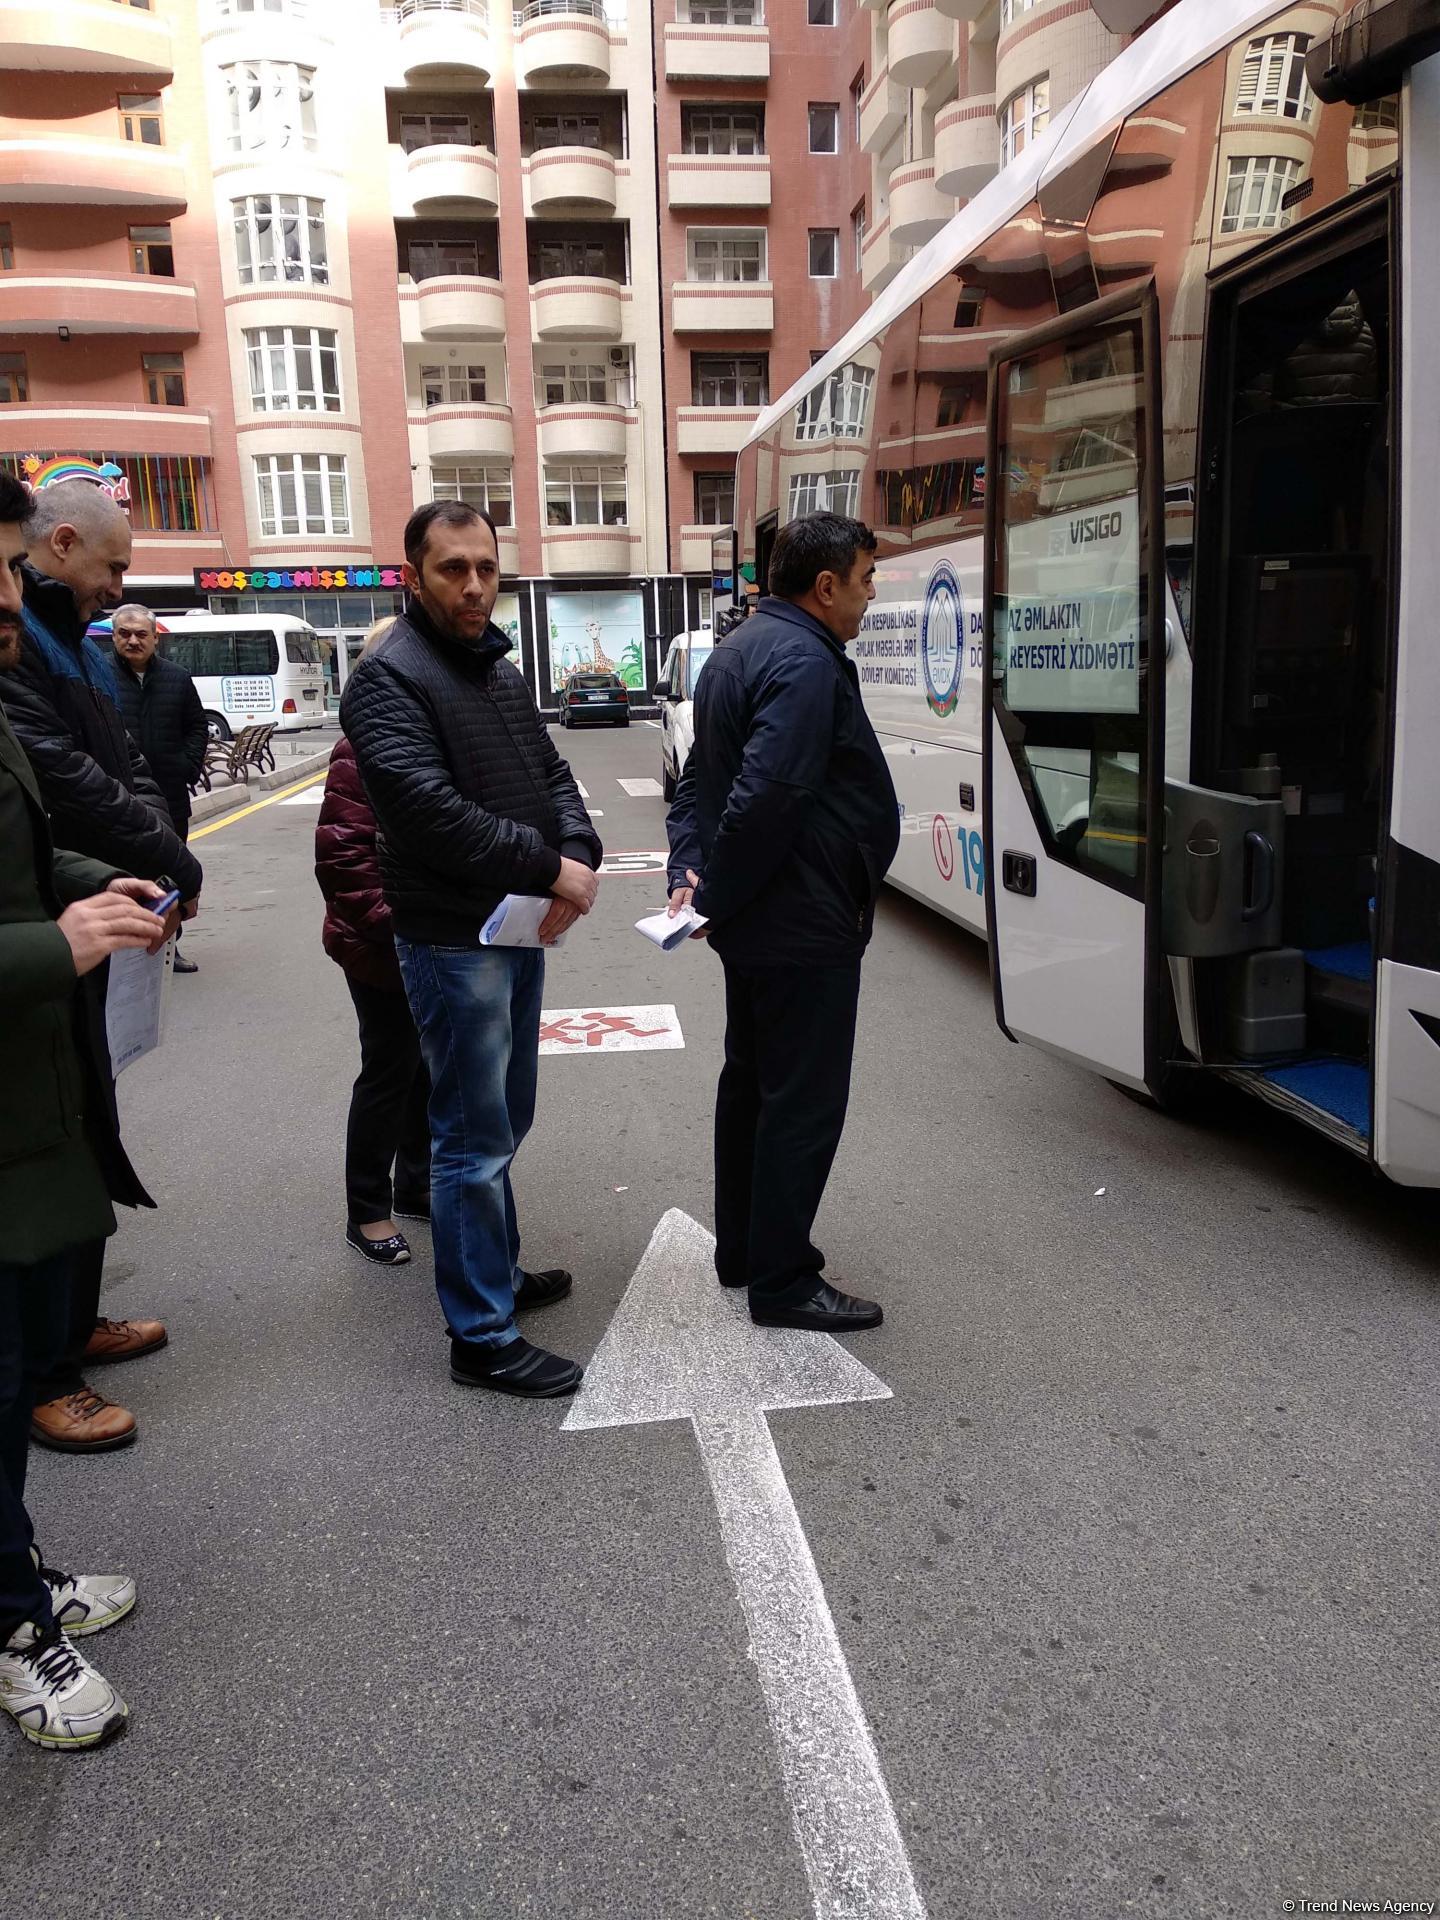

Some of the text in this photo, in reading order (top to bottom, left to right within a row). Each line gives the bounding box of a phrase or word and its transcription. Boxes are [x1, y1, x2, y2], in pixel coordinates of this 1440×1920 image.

[1070, 511, 1122, 544] VISIGO
[200, 571, 247, 591] XOŞ
[1024, 602, 1081, 631] ƏMLAKIN
[1010, 638, 1066, 669] REYESTRİ
[1069, 633, 1135, 670] XİDMƏTİ
